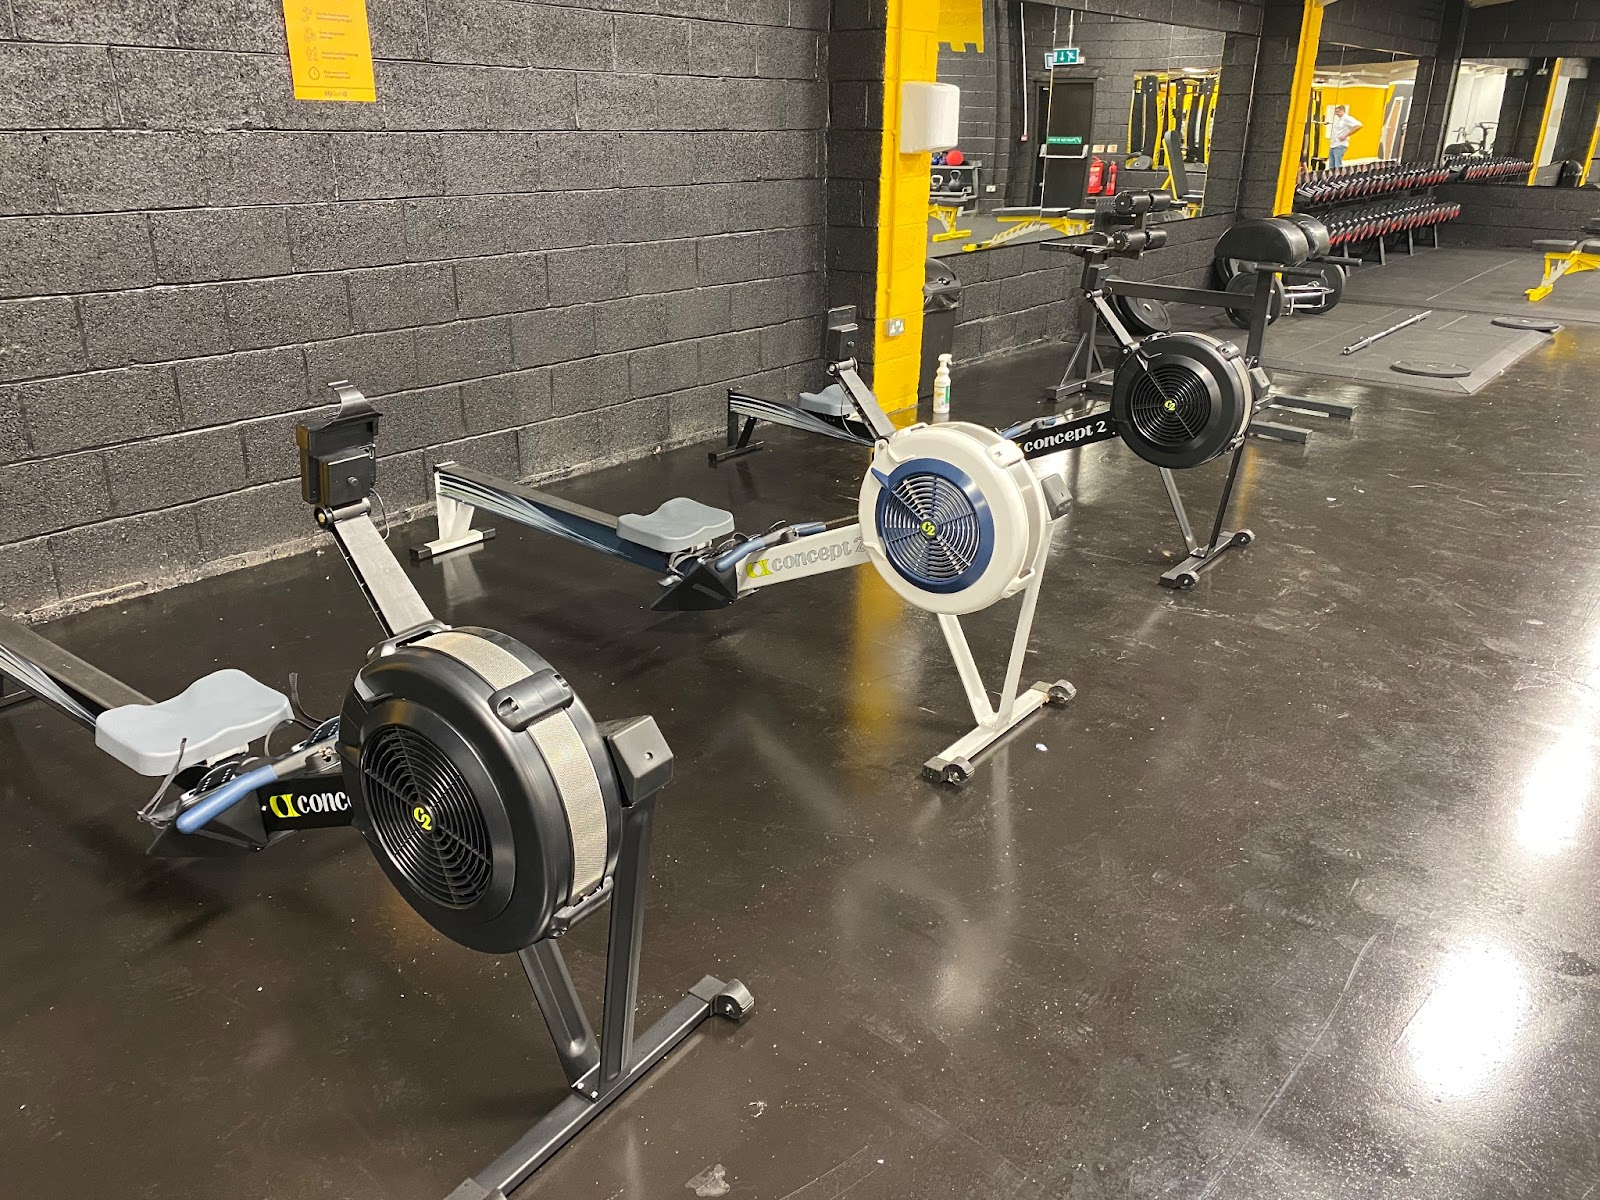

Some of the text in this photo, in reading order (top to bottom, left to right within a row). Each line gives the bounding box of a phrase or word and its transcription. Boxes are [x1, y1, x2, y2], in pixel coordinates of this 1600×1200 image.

[1023, 420, 1108, 453] concept 2
[771, 540, 852, 572] concept
[853, 536, 867, 553] 2
[296, 791, 352, 814] conc
